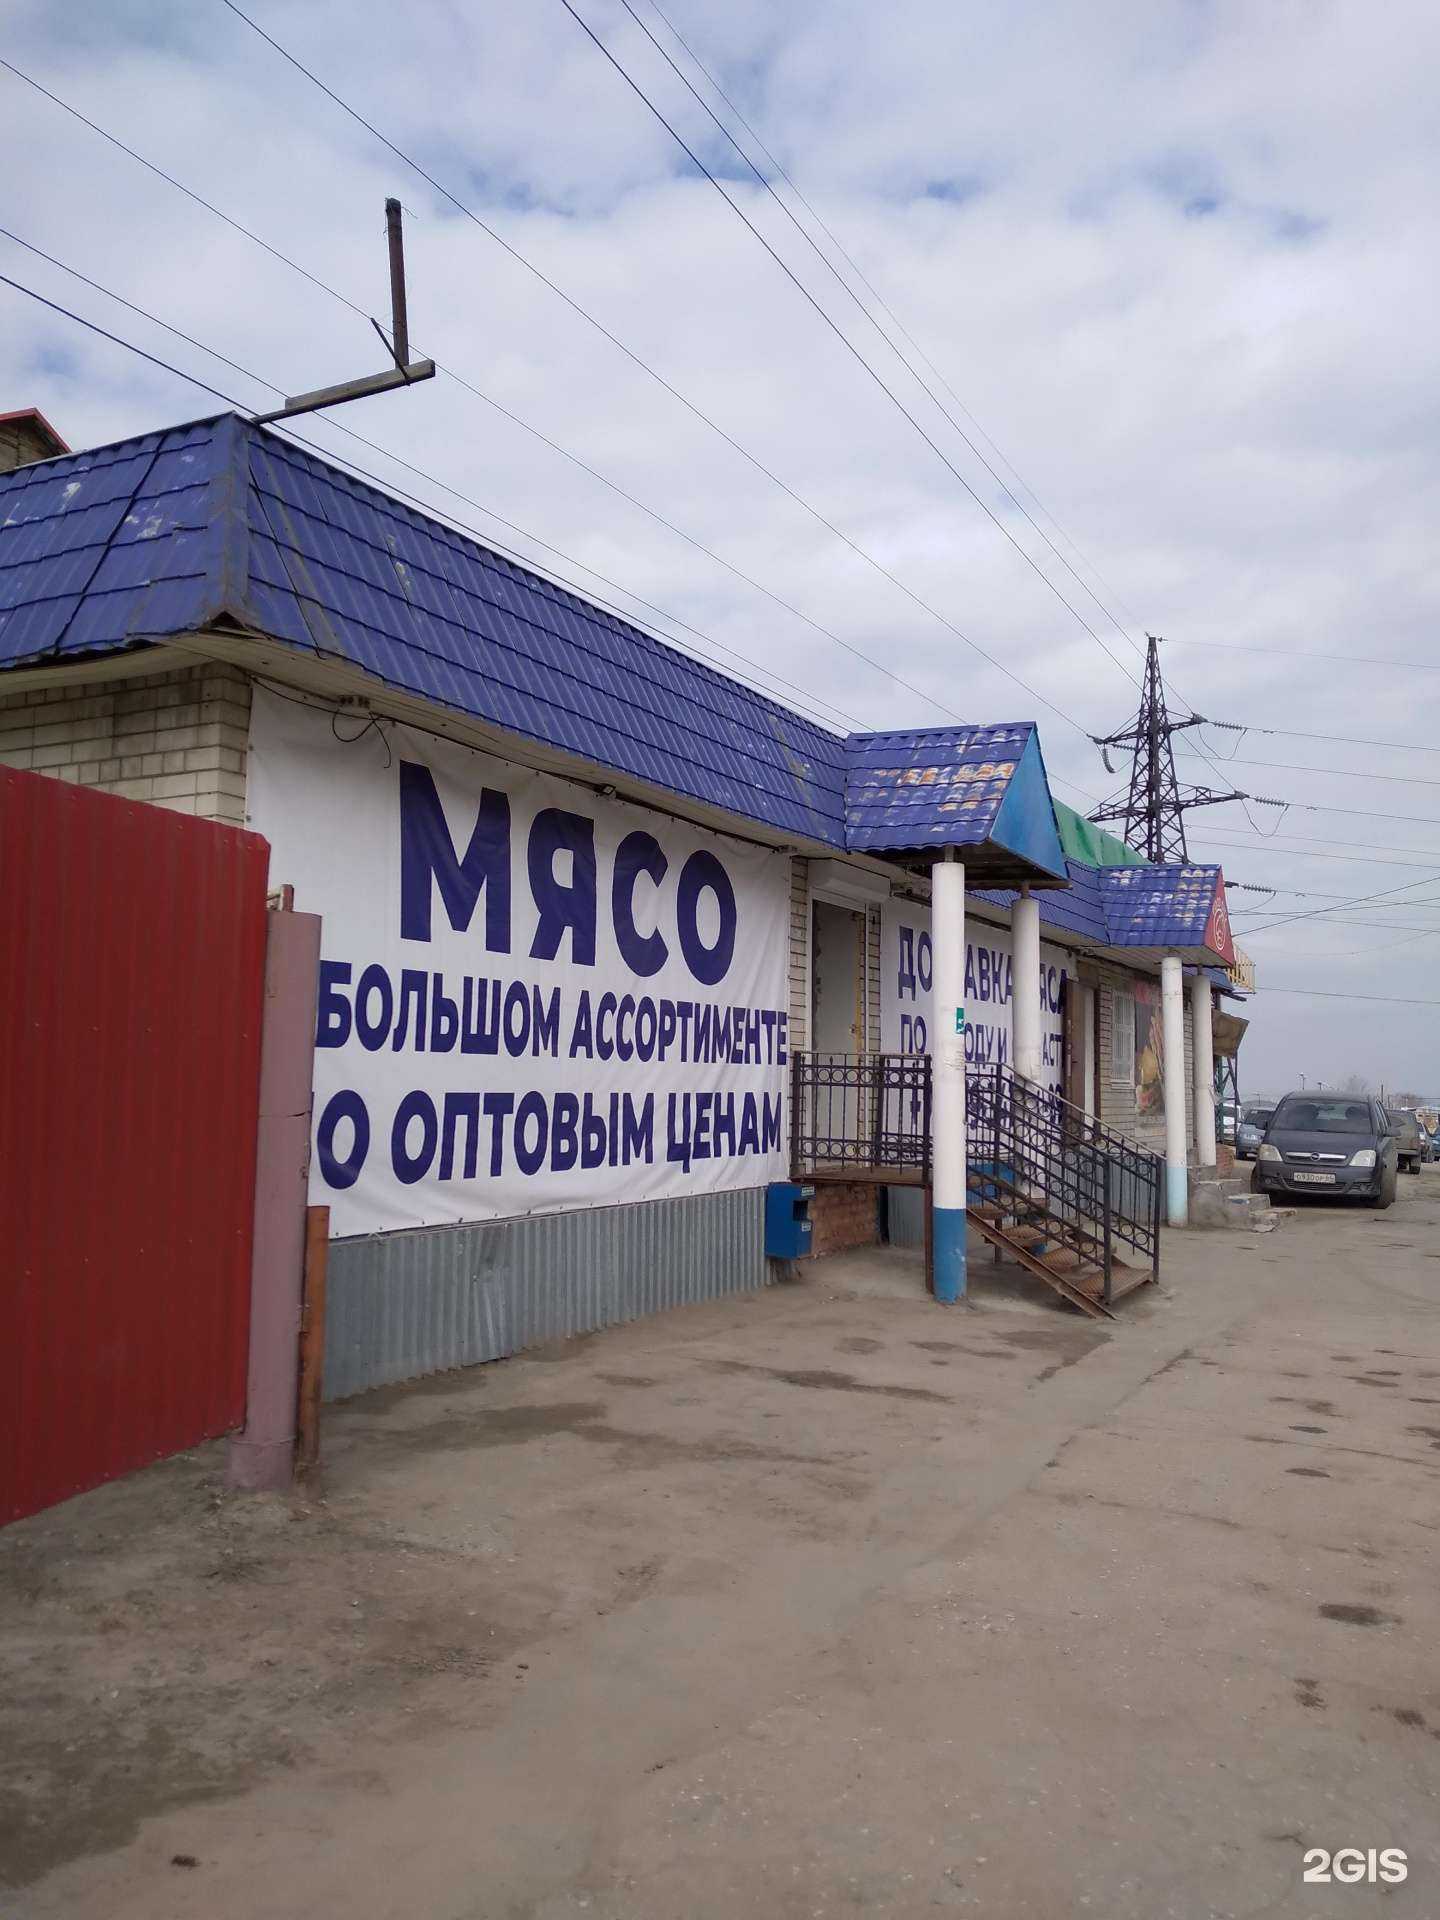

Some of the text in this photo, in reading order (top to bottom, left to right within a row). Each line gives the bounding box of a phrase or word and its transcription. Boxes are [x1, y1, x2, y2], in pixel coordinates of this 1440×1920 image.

[400, 759, 737, 986] МЯСО
[315, 959, 788, 1066] БОЛЬШОМ АССОРТИМЕНТЕ
[898, 925, 1012, 1005] ДОАВКА
[900, 1013, 927, 1054] ПО
[311, 1089, 783, 1190] О ОПТОВЫМ ЦЕНАМ
